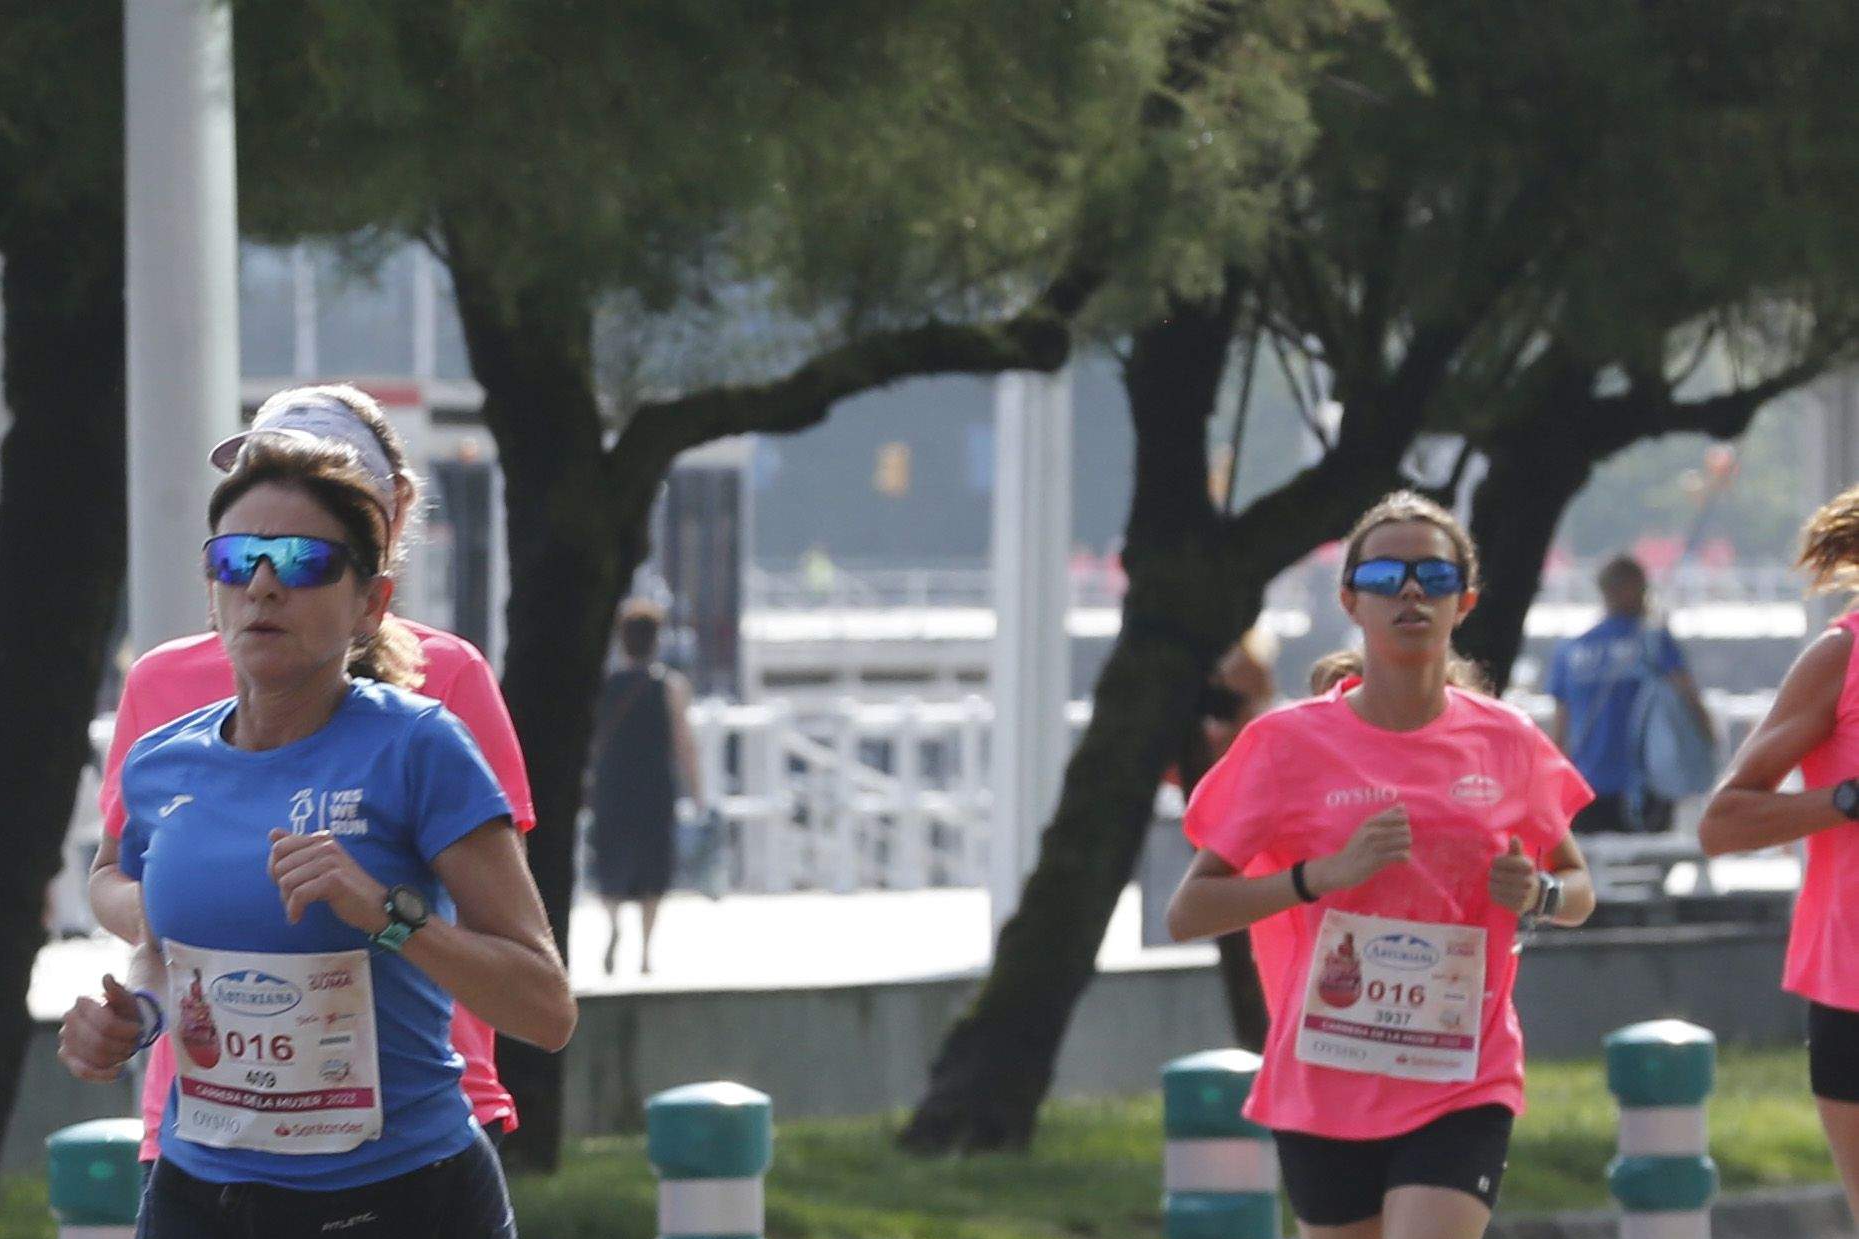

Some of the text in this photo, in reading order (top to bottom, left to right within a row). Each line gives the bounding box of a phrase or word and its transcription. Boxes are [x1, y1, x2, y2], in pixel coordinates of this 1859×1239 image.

[330, 788, 363, 804] YES
[329, 804, 358, 819] WE
[329, 819, 368, 835] RUN
[1368, 980, 1425, 1006] 016
[225, 1030, 296, 1061] 016
